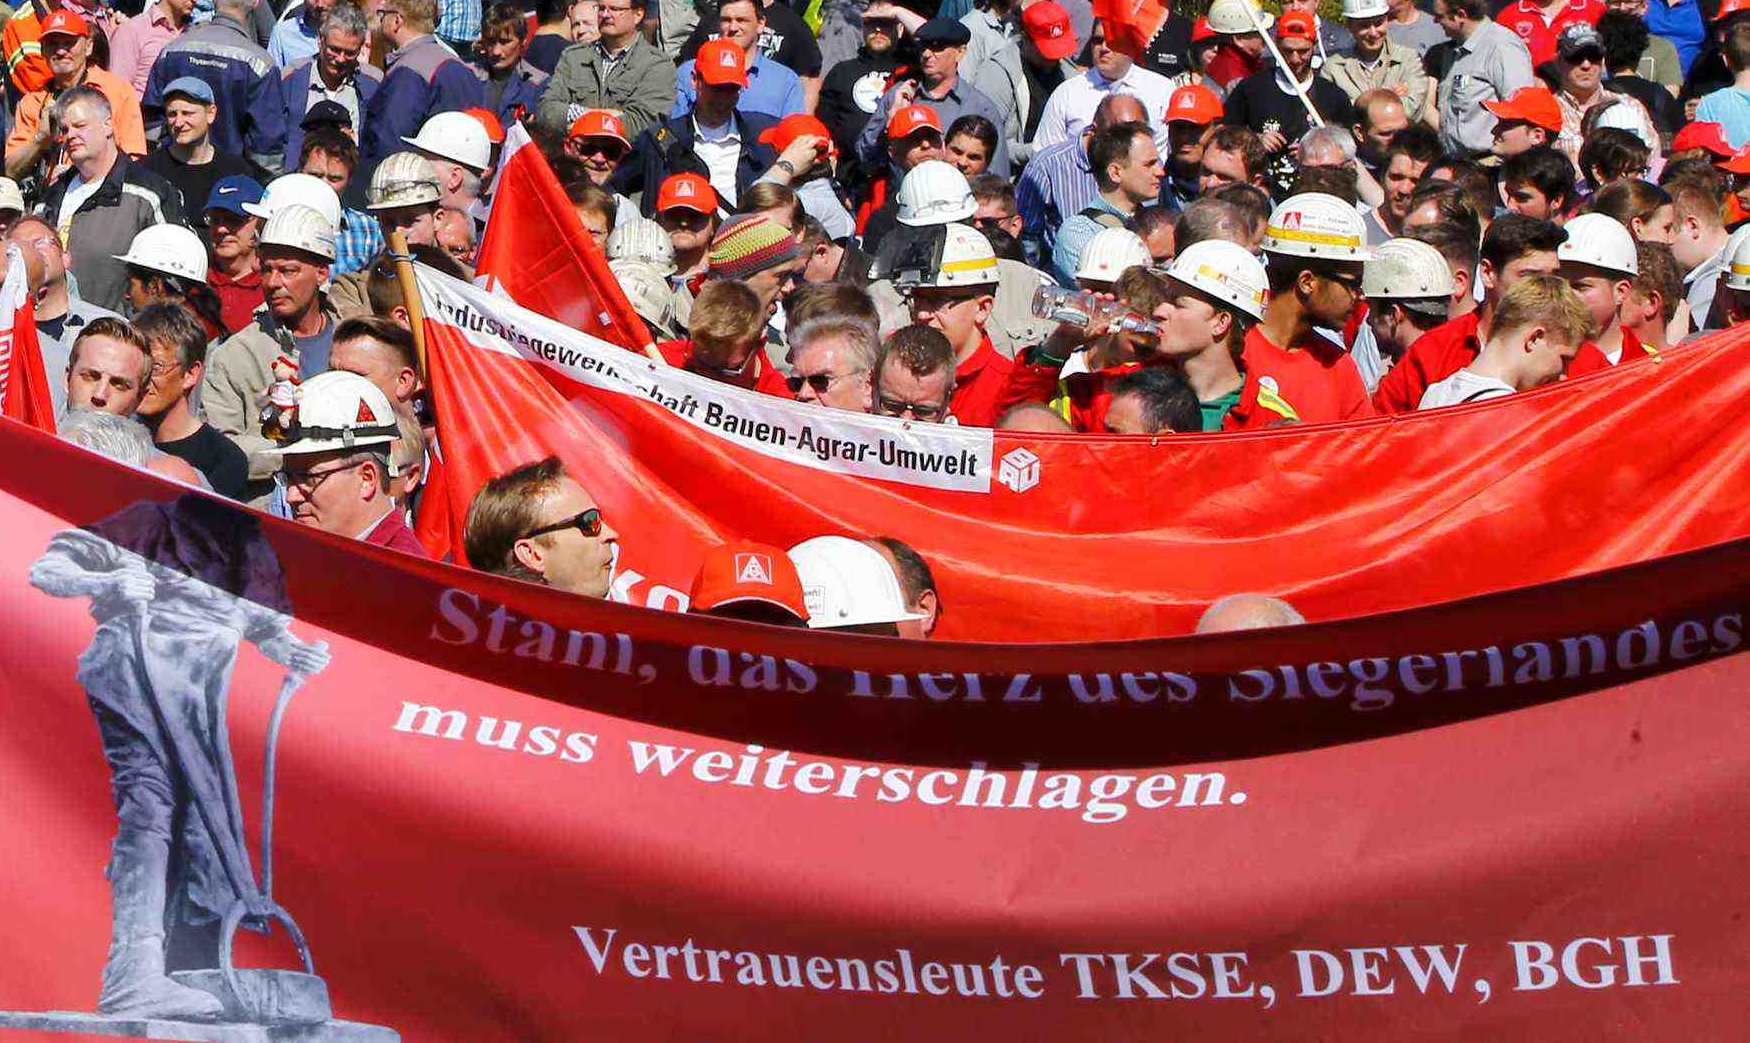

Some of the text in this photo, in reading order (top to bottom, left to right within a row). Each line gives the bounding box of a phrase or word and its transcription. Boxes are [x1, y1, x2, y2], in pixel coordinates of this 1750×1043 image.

[704, 401, 978, 476] Bauen-Agrar-Umwelt
[393, 699, 1248, 824] muss weiterschlagen.
[571, 925, 1678, 1008] Vertrauensleute TKSE, DEW, BGH
